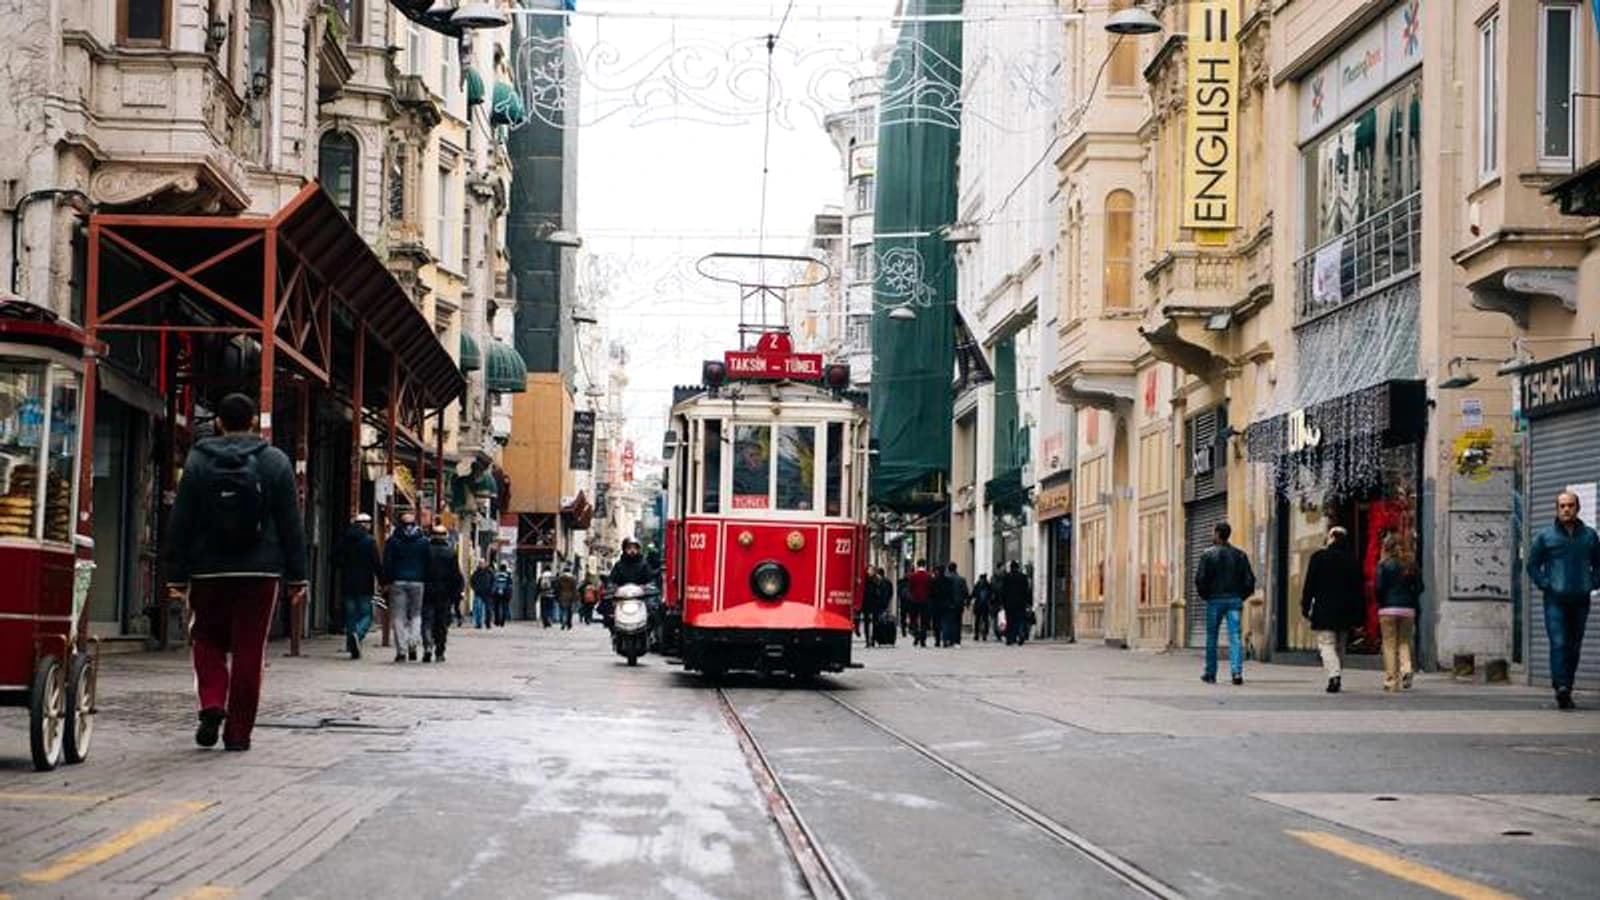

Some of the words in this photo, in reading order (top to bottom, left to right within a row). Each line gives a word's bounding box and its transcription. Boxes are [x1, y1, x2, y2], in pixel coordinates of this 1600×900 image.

[1194, 58, 1230, 222] ENGLISH
[770, 334, 778, 349] 2
[689, 533, 706, 549] 223
